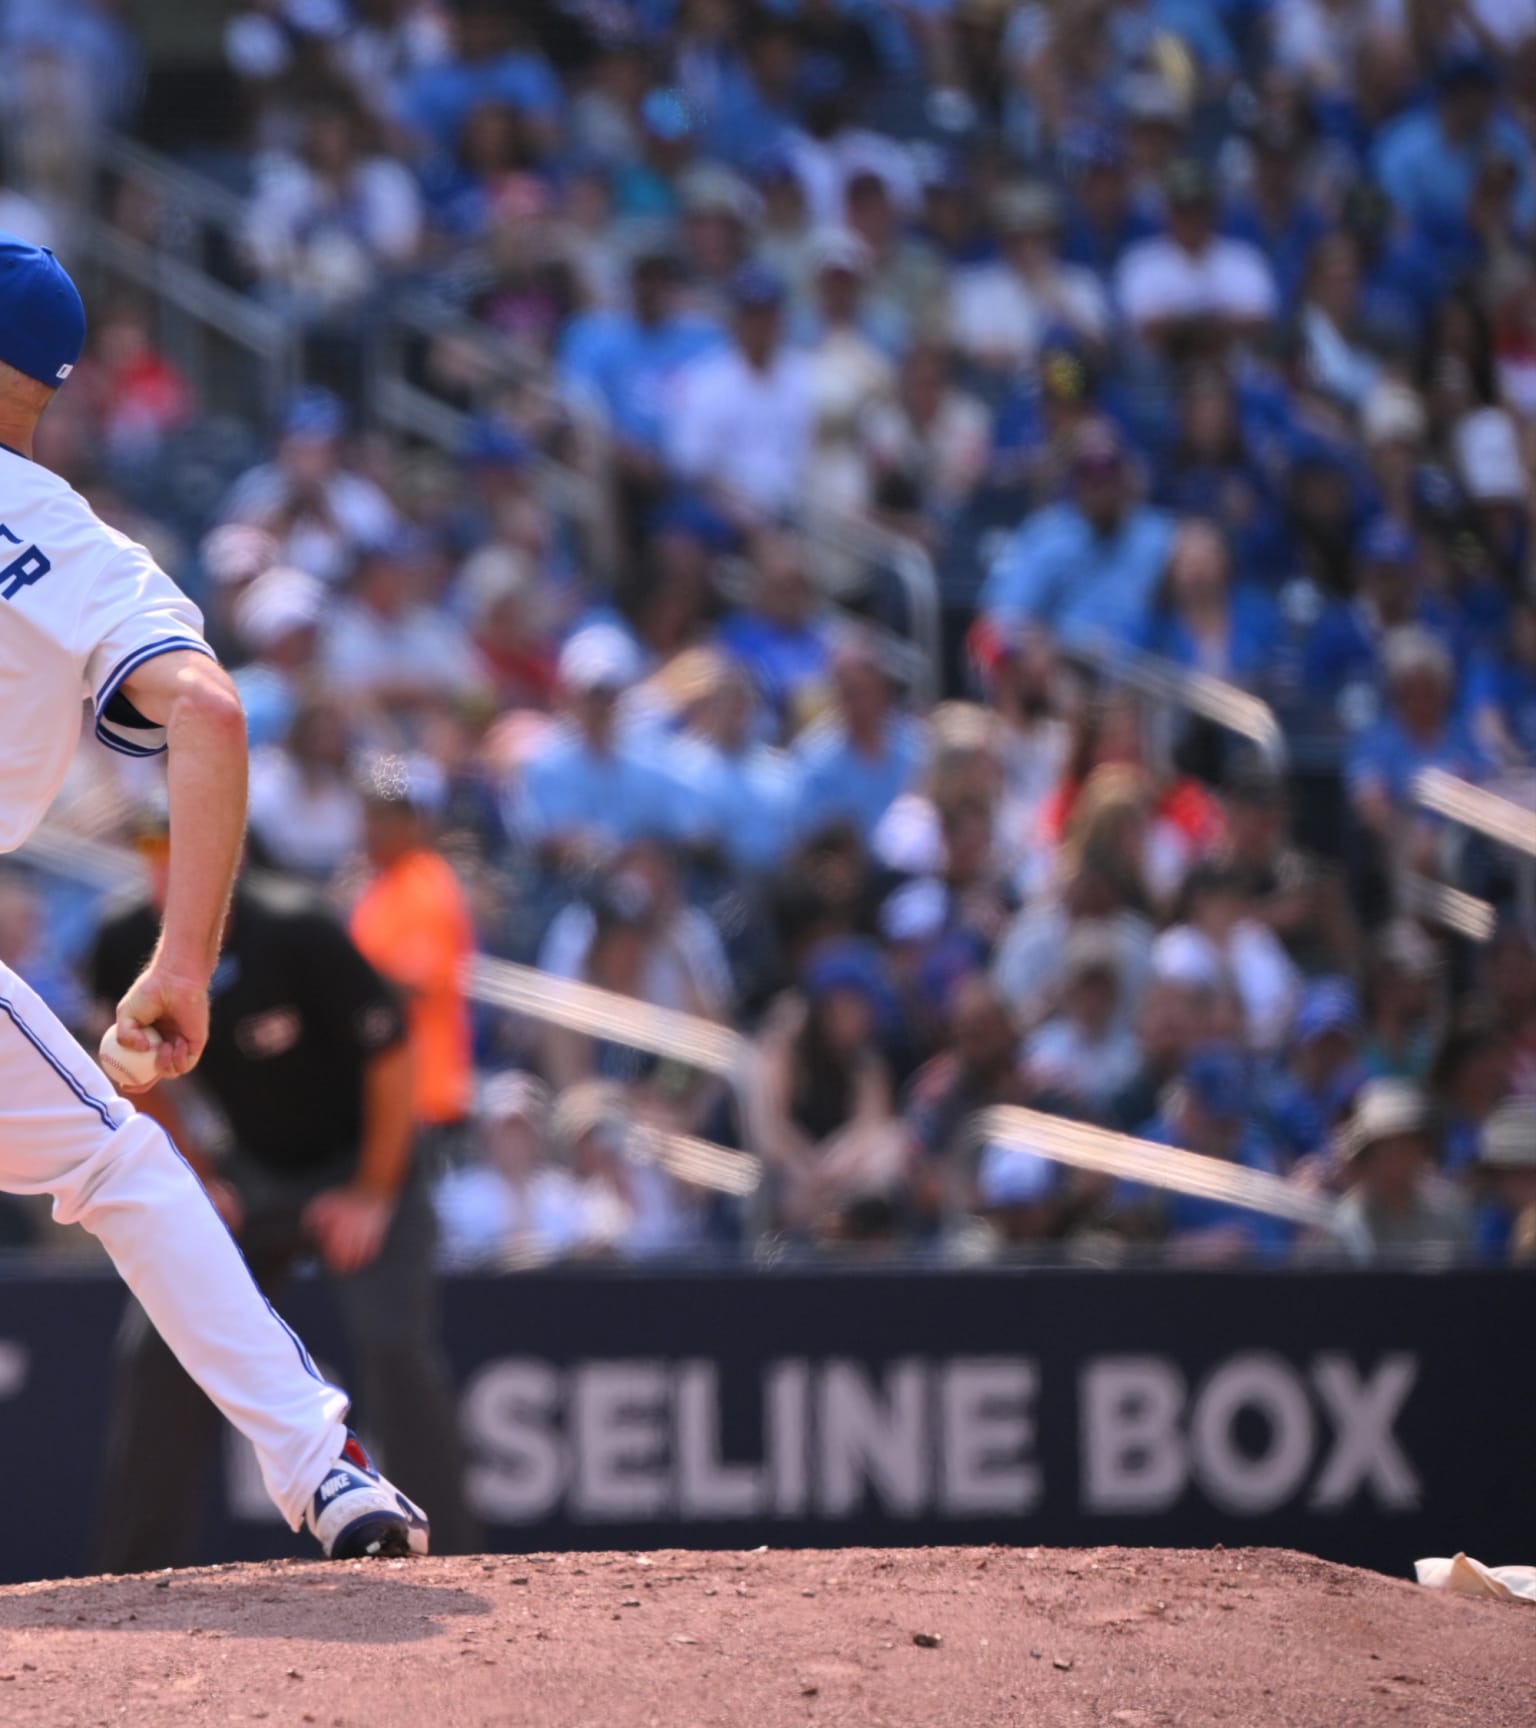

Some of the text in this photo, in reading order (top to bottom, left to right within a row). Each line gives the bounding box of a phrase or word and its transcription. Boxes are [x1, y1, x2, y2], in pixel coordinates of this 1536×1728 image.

[226, 1354, 1044, 1523] SELINE
[1078, 1347, 1421, 1514] BOX
[320, 1473, 351, 1501] NIKE
